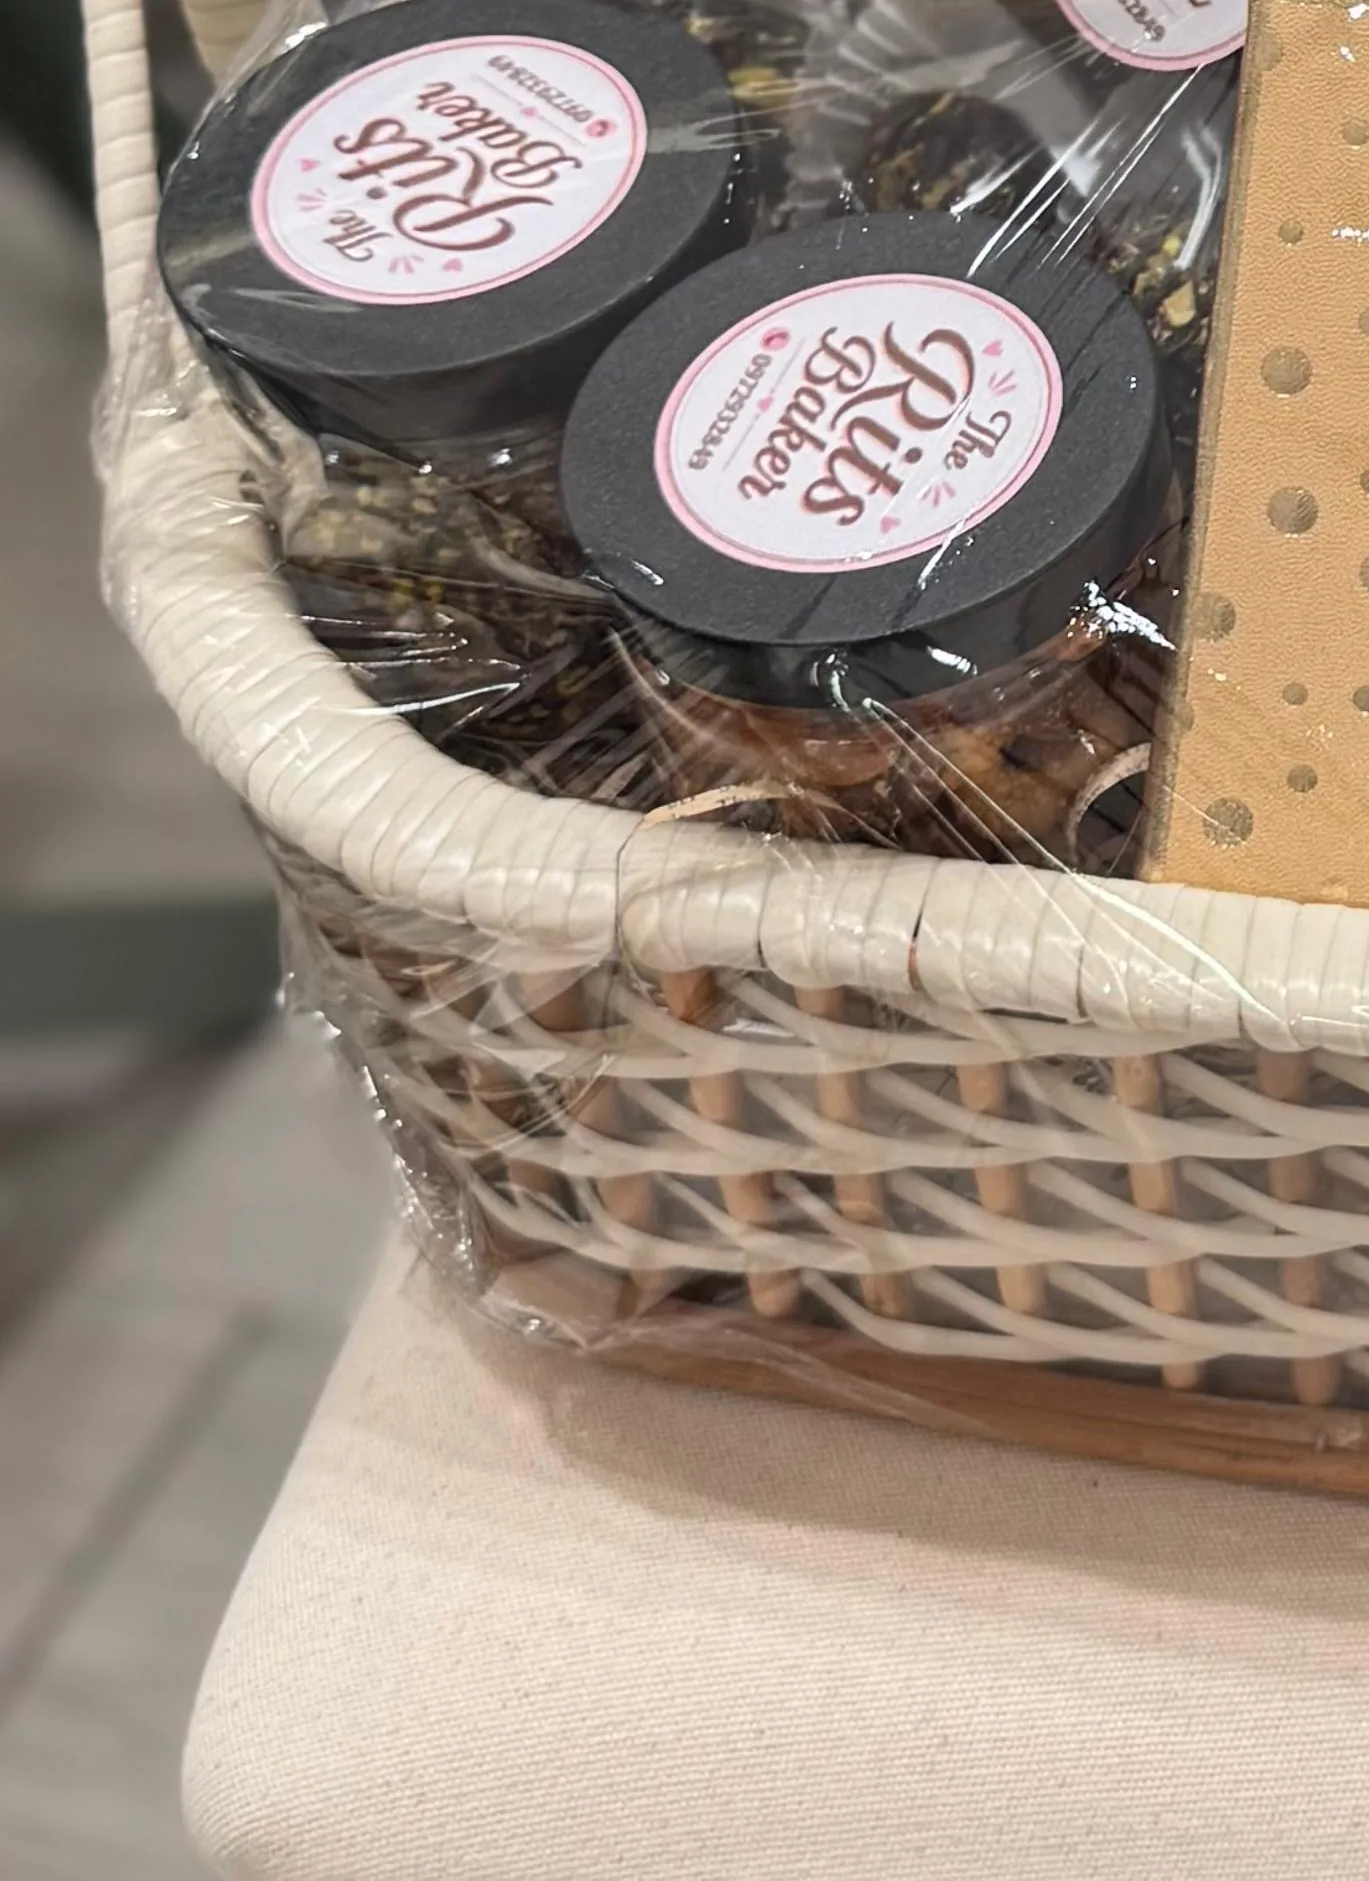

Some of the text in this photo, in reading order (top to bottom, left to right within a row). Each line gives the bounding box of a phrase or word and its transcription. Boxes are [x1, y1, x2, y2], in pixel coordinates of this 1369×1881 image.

[333, 117, 555, 252] Rits
[416, 81, 583, 189] Baker
[322, 209, 396, 262] The
[737, 326, 876, 500] Baker
[800, 320, 977, 527] Rits
[943, 409, 1012, 473] The
